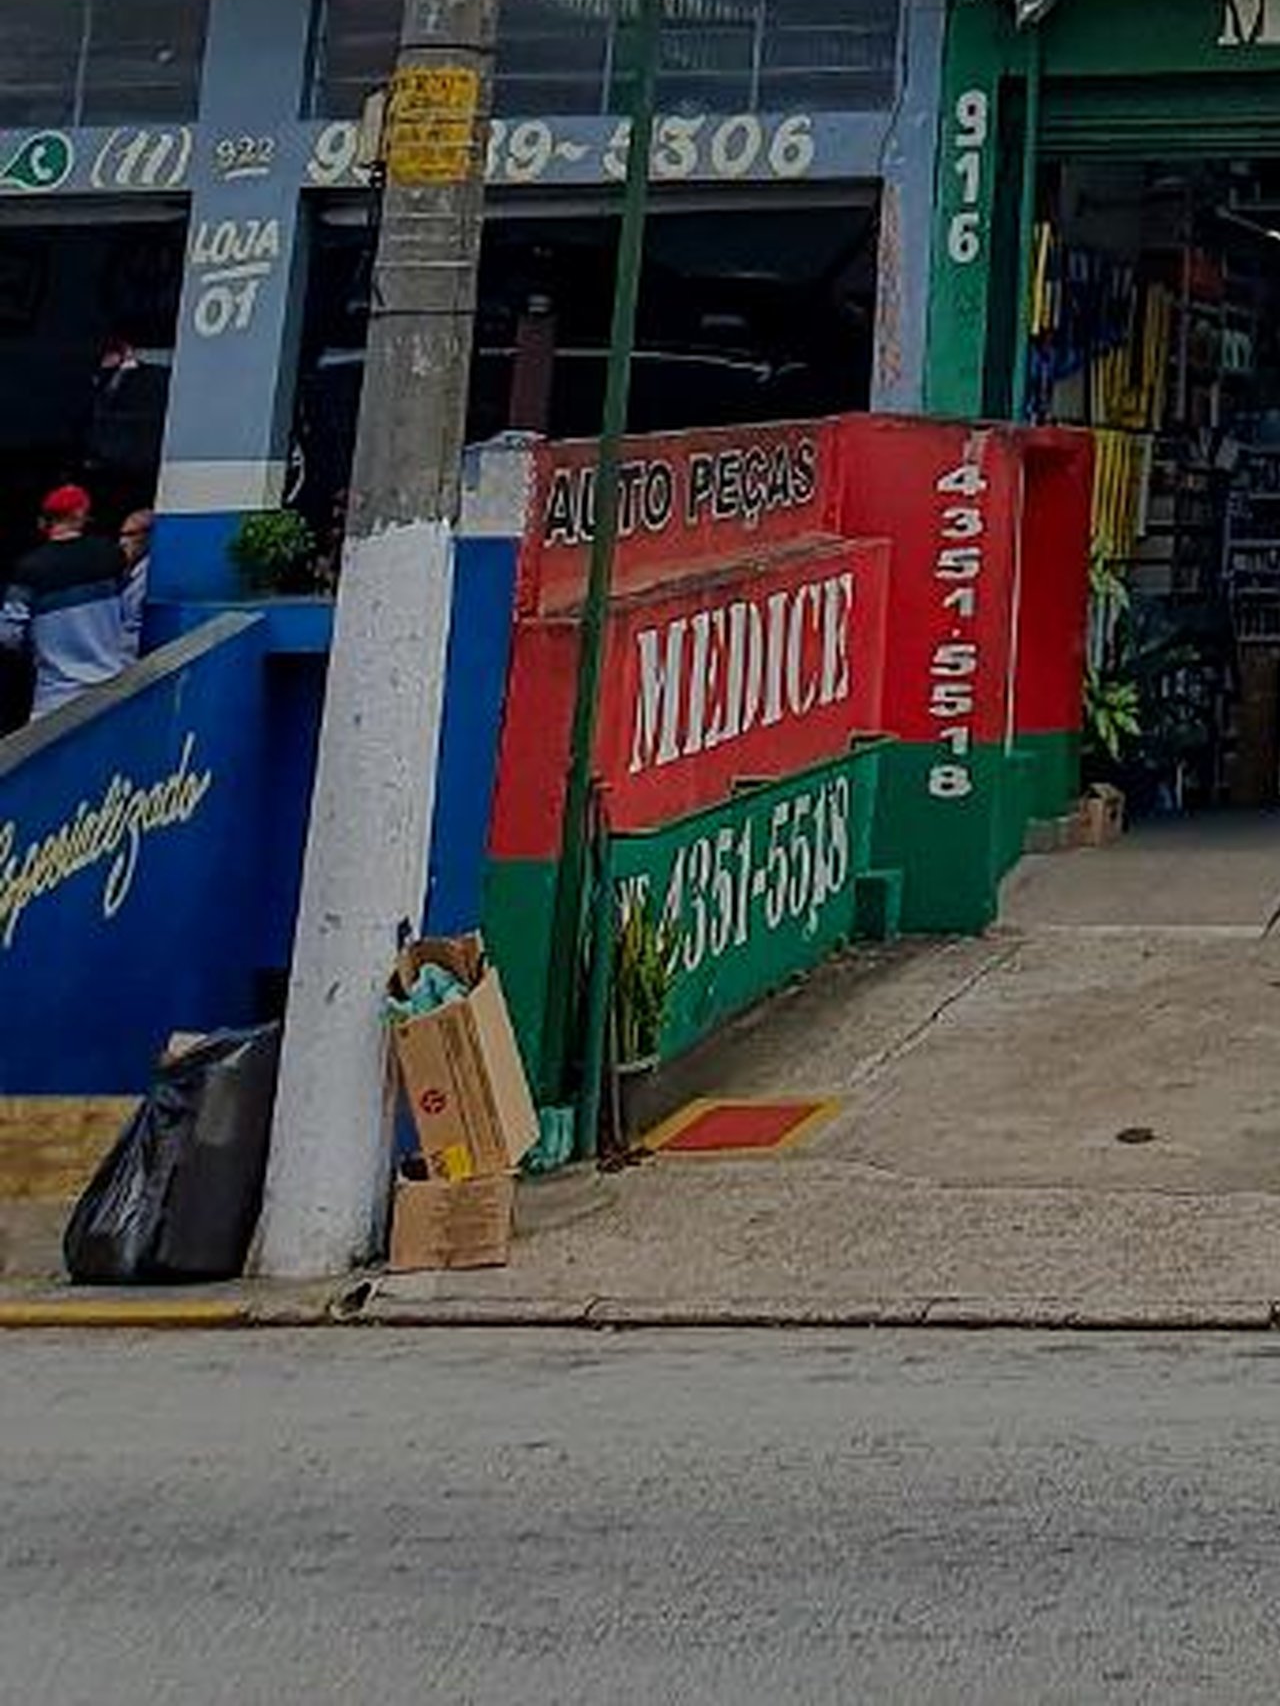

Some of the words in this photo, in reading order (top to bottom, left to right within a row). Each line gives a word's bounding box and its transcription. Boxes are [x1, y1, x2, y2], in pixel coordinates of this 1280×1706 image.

[191, 219, 279, 264] LOJA
[945, 88, 988, 265] 916
[686, 439, 818, 531] PEÇAS
[628, 571, 855, 774] MEDICE
